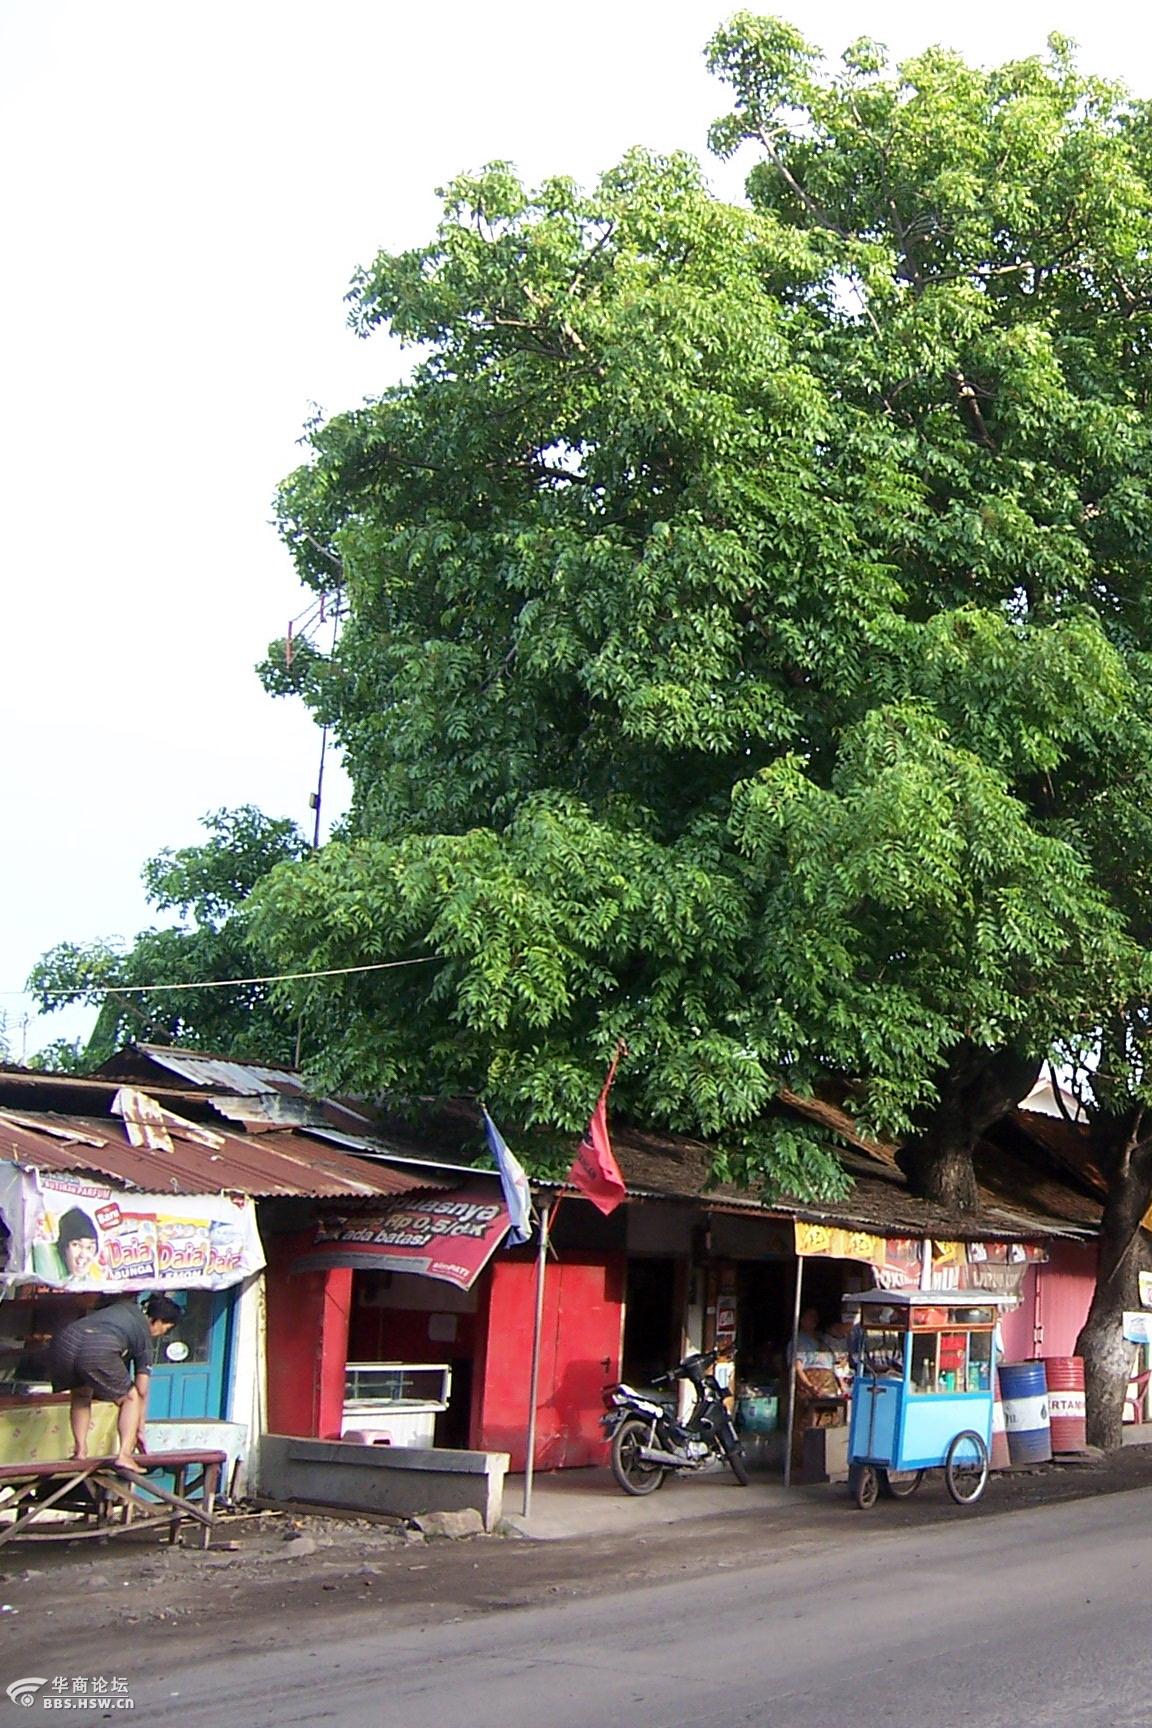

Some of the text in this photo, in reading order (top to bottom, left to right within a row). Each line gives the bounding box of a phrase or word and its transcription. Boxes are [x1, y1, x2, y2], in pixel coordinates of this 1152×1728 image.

[342, 1228, 374, 1241] ada
[374, 1230, 432, 1246] batas!
[108, 1239, 153, 1269] Daia
[157, 1241, 205, 1270] Daia
